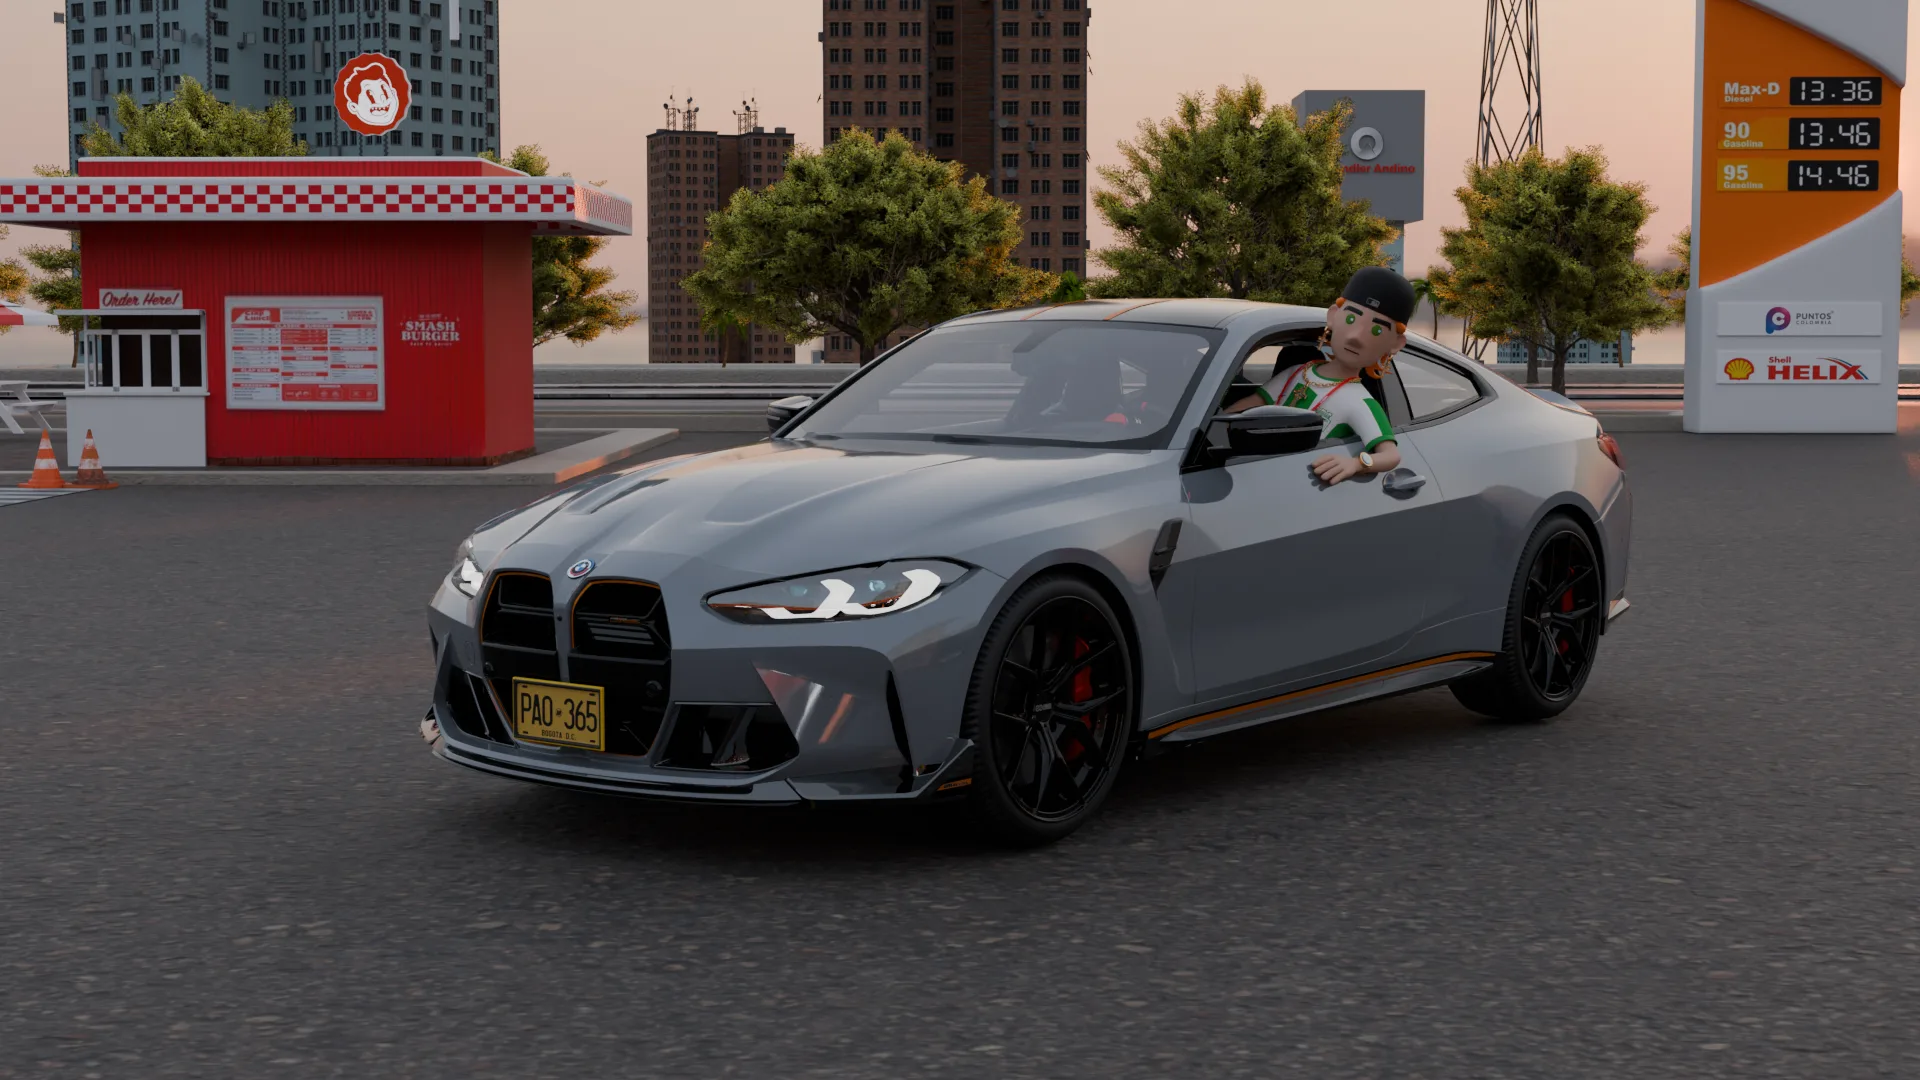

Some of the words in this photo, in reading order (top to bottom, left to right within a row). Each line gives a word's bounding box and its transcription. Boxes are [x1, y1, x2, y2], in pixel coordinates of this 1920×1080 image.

[1724, 82, 1780, 95] Max-D
[1801, 80, 1873, 101] 13.36
[1724, 121, 1750, 139] 90
[1800, 122, 1871, 147] 13.46
[1723, 139, 1764, 148] Gasolina
[1373, 163, 1416, 173] Andino
[1723, 164, 1749, 181] 95
[1798, 165, 1870, 187] 14.46
[1723, 181, 1763, 189] Gasolina
[102, 291, 140, 307] Order
[143, 292, 180, 306] Here!
[1795, 312, 1832, 320] PUNTOS
[405, 320, 455, 331] SMASH
[401, 331, 460, 341] BURGER
[1768, 356, 1792, 364] Shell
[1767, 365, 1865, 380] HELIX
[563, 698, 598, 733] 365
[541, 729, 563, 739] BOGOTA
